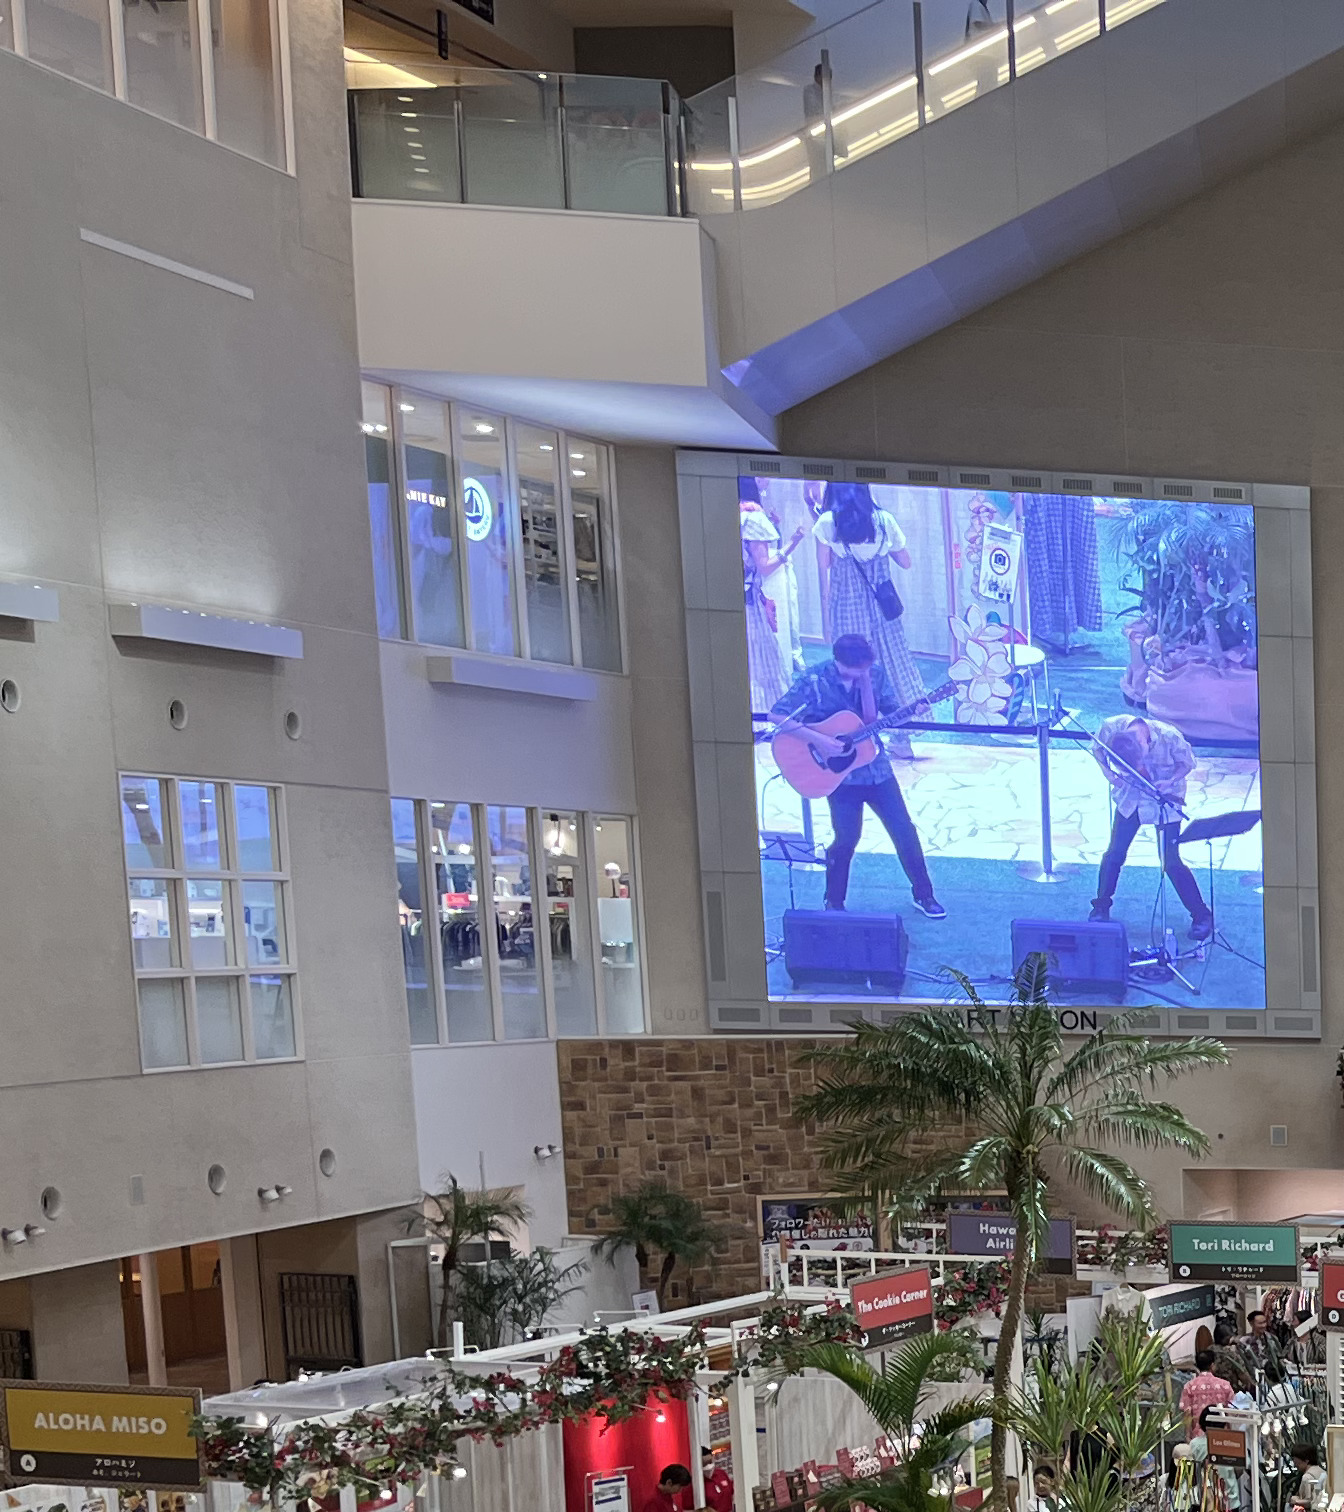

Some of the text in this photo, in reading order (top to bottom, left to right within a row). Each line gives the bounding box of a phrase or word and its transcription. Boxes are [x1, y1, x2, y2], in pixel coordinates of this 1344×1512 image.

[1192, 1238, 1274, 1252] Tori Richard
[857, 1289, 928, 1315] The Cookie Corner
[33, 1411, 168, 1436] ALOHA MISO
